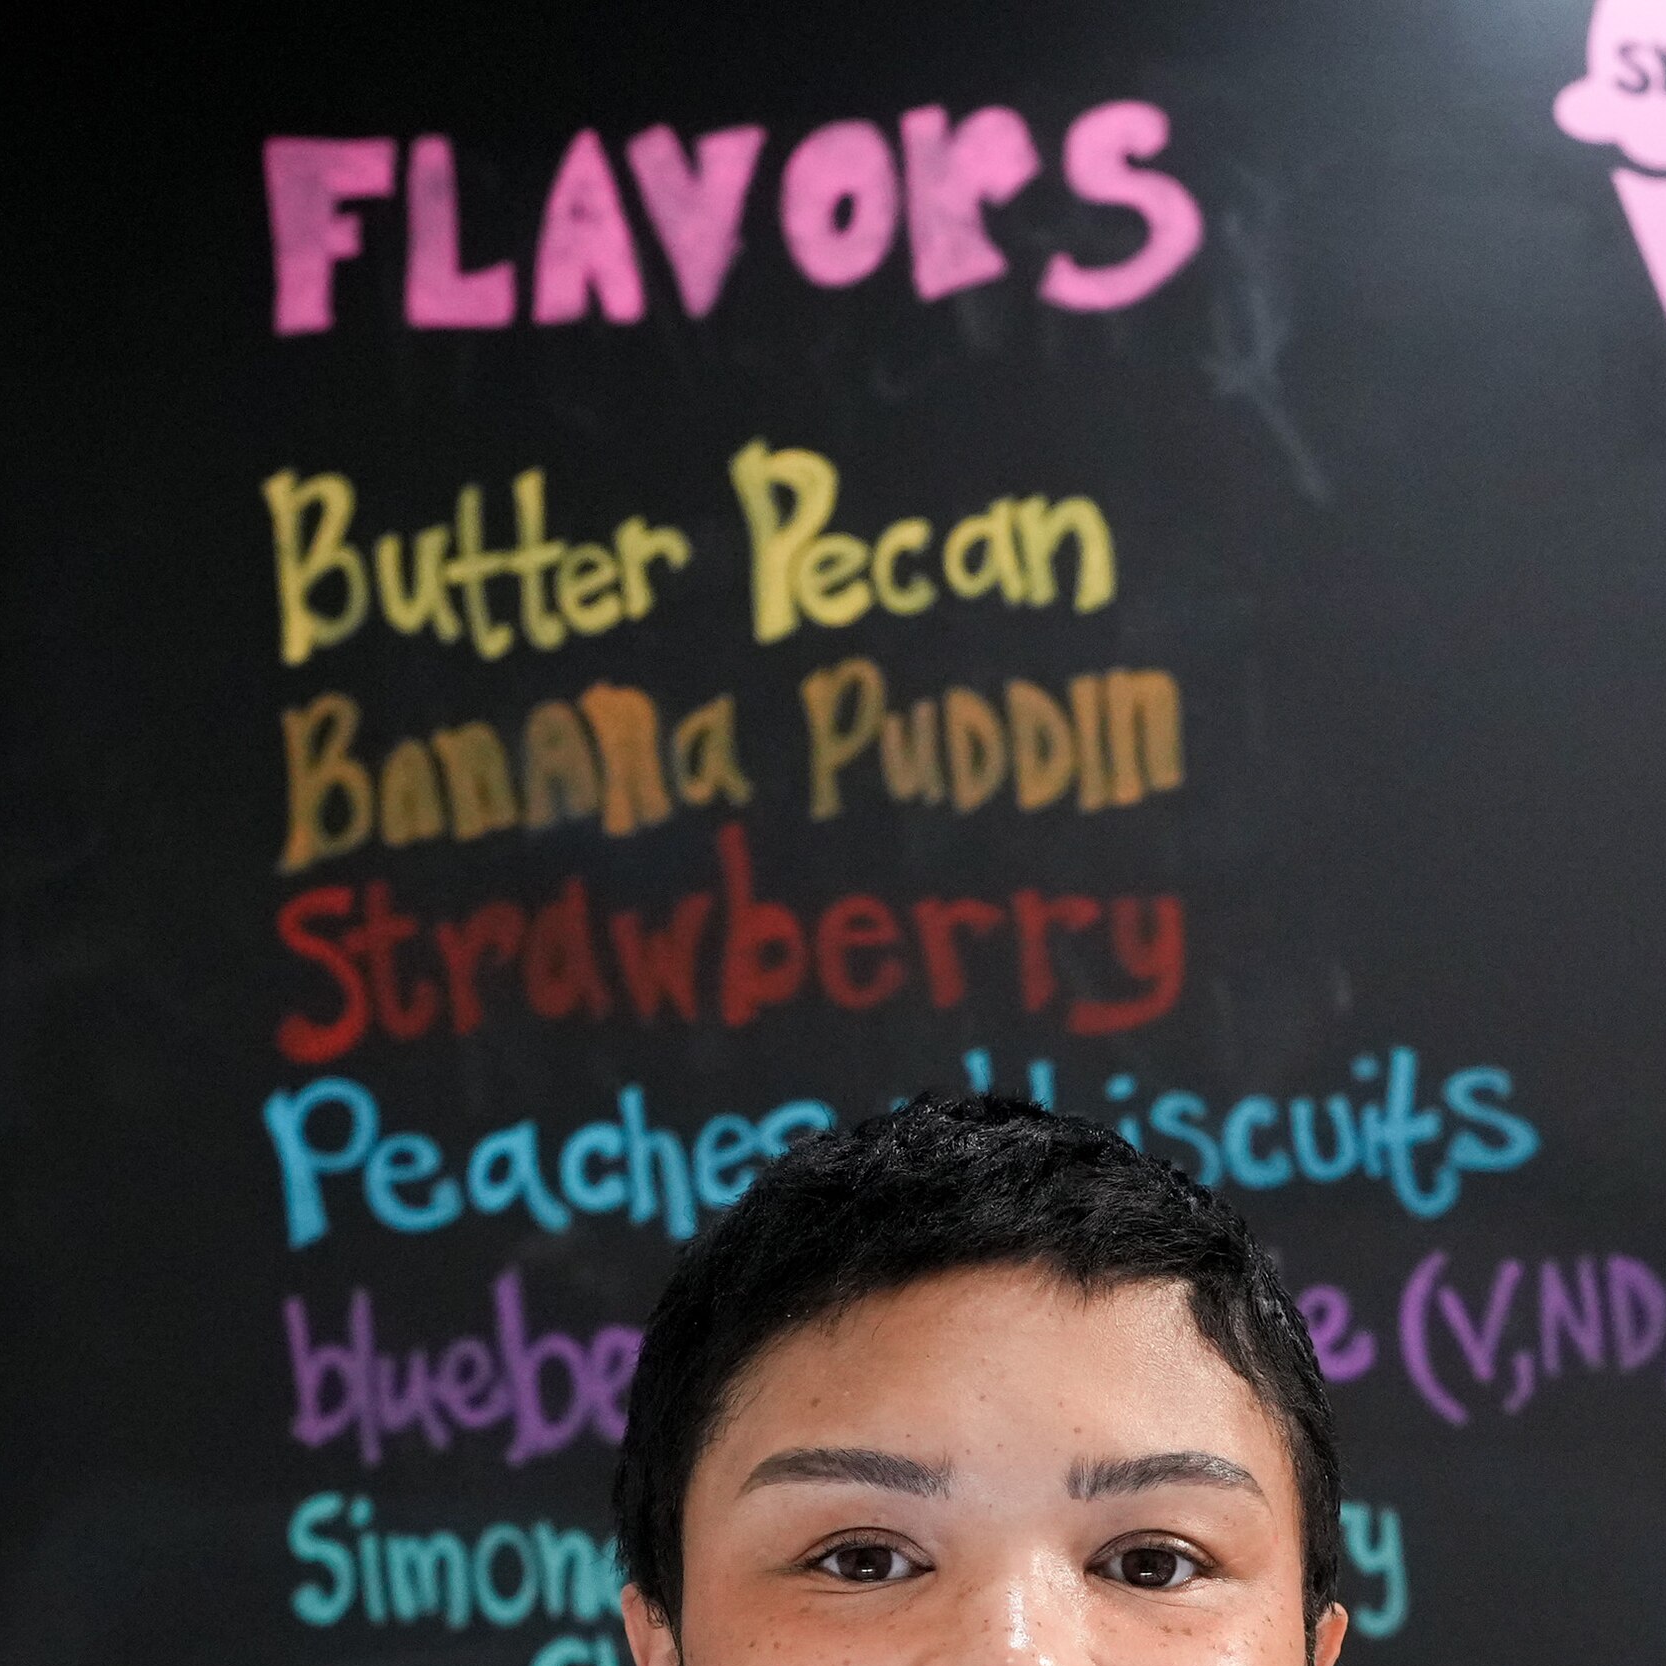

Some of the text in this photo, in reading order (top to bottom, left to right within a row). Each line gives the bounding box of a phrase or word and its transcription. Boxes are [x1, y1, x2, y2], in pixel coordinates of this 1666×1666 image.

[263, 437, 1117, 665] Butter Pecan
[275, 822, 1186, 1065] Strawberry
[1028, 1045, 1541, 1218] iscuits
[287, 1491, 625, 1628] Simon
